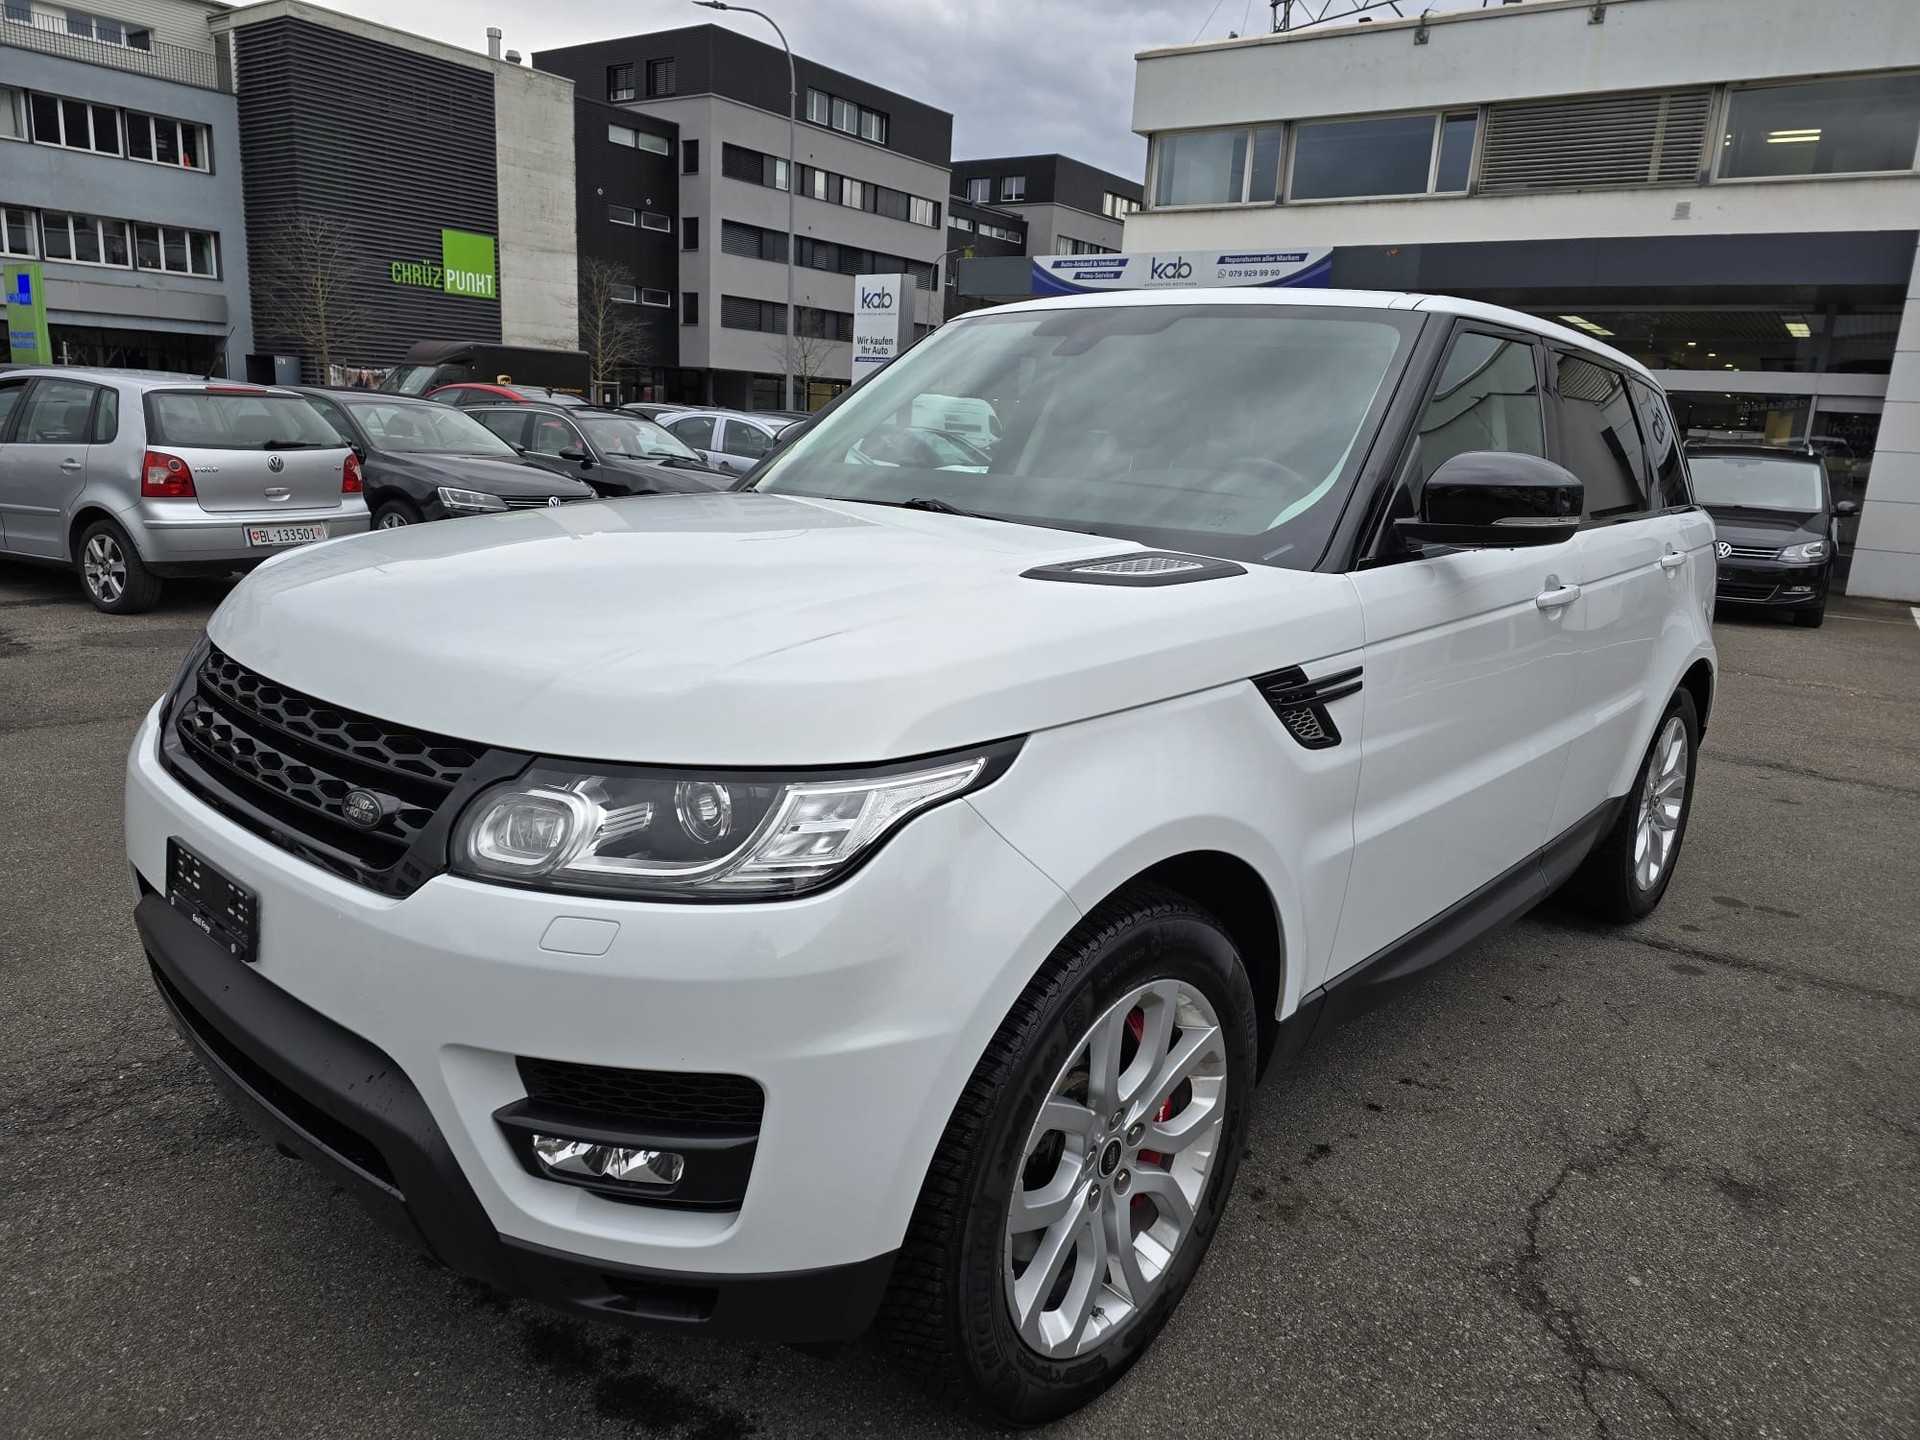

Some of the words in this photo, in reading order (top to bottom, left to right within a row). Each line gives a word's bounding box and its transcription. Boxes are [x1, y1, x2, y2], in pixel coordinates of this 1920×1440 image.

[1061, 260, 1092, 268] Auto-Ankauf
[1099, 259, 1119, 267] Verkauf
[1224, 256, 1261, 264] Reparaturen
[1276, 254, 1300, 262] Marken
[1150, 255, 1193, 280] kab
[392, 260, 443, 288] CHRÜZ
[446, 268, 493, 295] PUNKT
[1228, 270, 1242, 278] 079
[1243, 269, 1258, 278] 929
[1259, 269, 1269, 277] 99
[1270, 269, 1280, 277] 90
[861, 286, 893, 310] kab
[857, 335, 869, 345] Wir
[870, 335, 894, 346] kaufen
[861, 345, 871, 355] Ihr
[872, 345, 889, 355] Auto
[194, 466, 219, 474] POLO
[349, 794, 370, 810] LAND
[349, 805, 374, 824] ROVER
